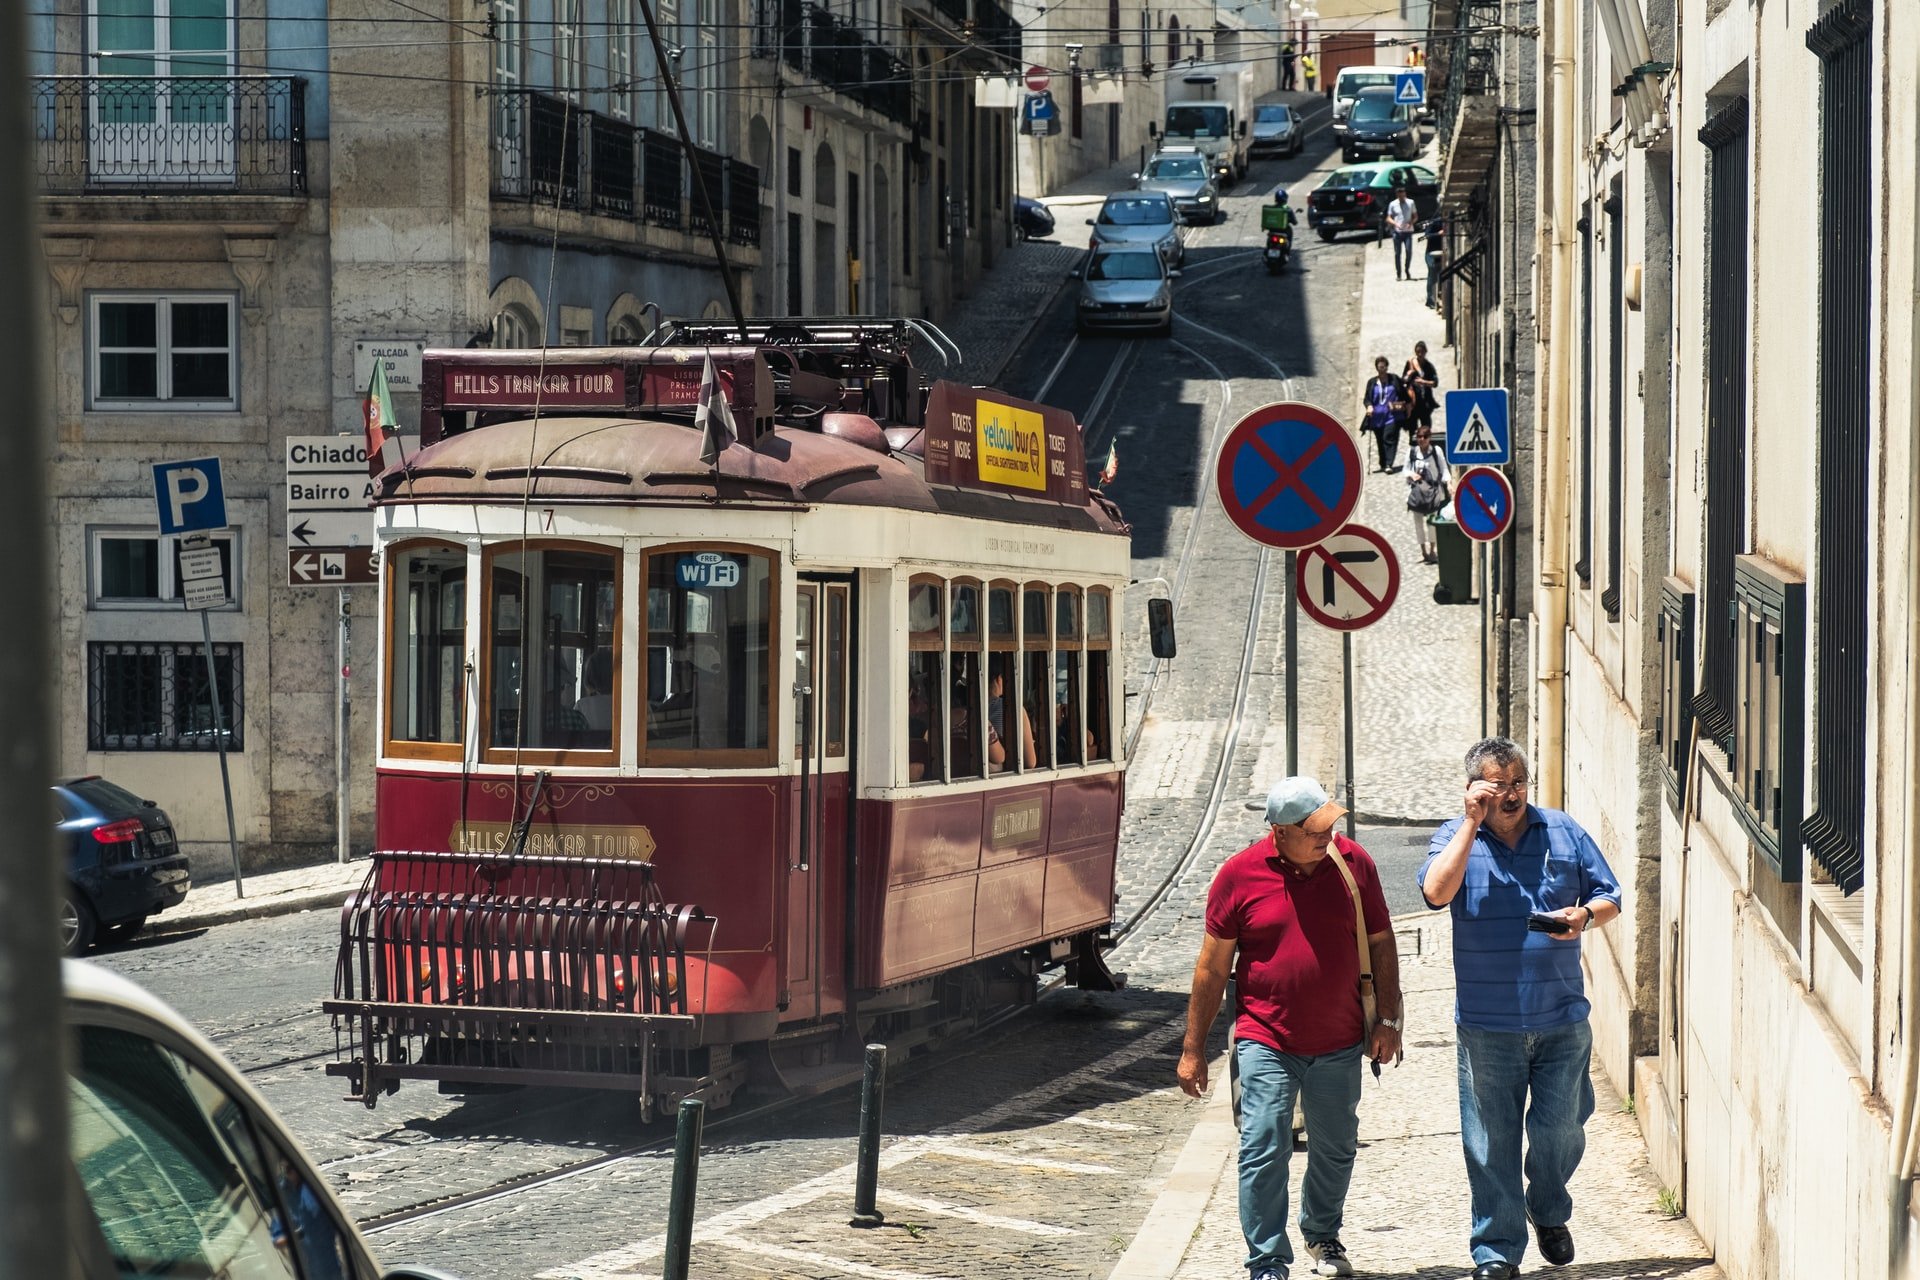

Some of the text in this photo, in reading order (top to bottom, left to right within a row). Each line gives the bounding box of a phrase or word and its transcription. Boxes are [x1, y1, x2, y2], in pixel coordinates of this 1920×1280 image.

[1031, 98, 1046, 117] P
[385, 362, 396, 371] DO
[454, 374, 614, 394] HILLS TRAMCAR TOUR
[670, 381, 702, 389] PREMIU
[671, 391, 701, 399] TRAMCA
[952, 412, 972, 433] TICKETS
[954, 440, 971, 460] INSIDE
[1049, 433, 1066, 453] TICKETS
[290, 444, 367, 463] Chiado
[1051, 459, 1066, 477] INSIDE
[166, 467, 209, 527] P
[290, 484, 350, 500] Bairro
[543, 509, 554, 531] 7
[459, 830, 641, 856] HILLS RAMCAR TOUR
